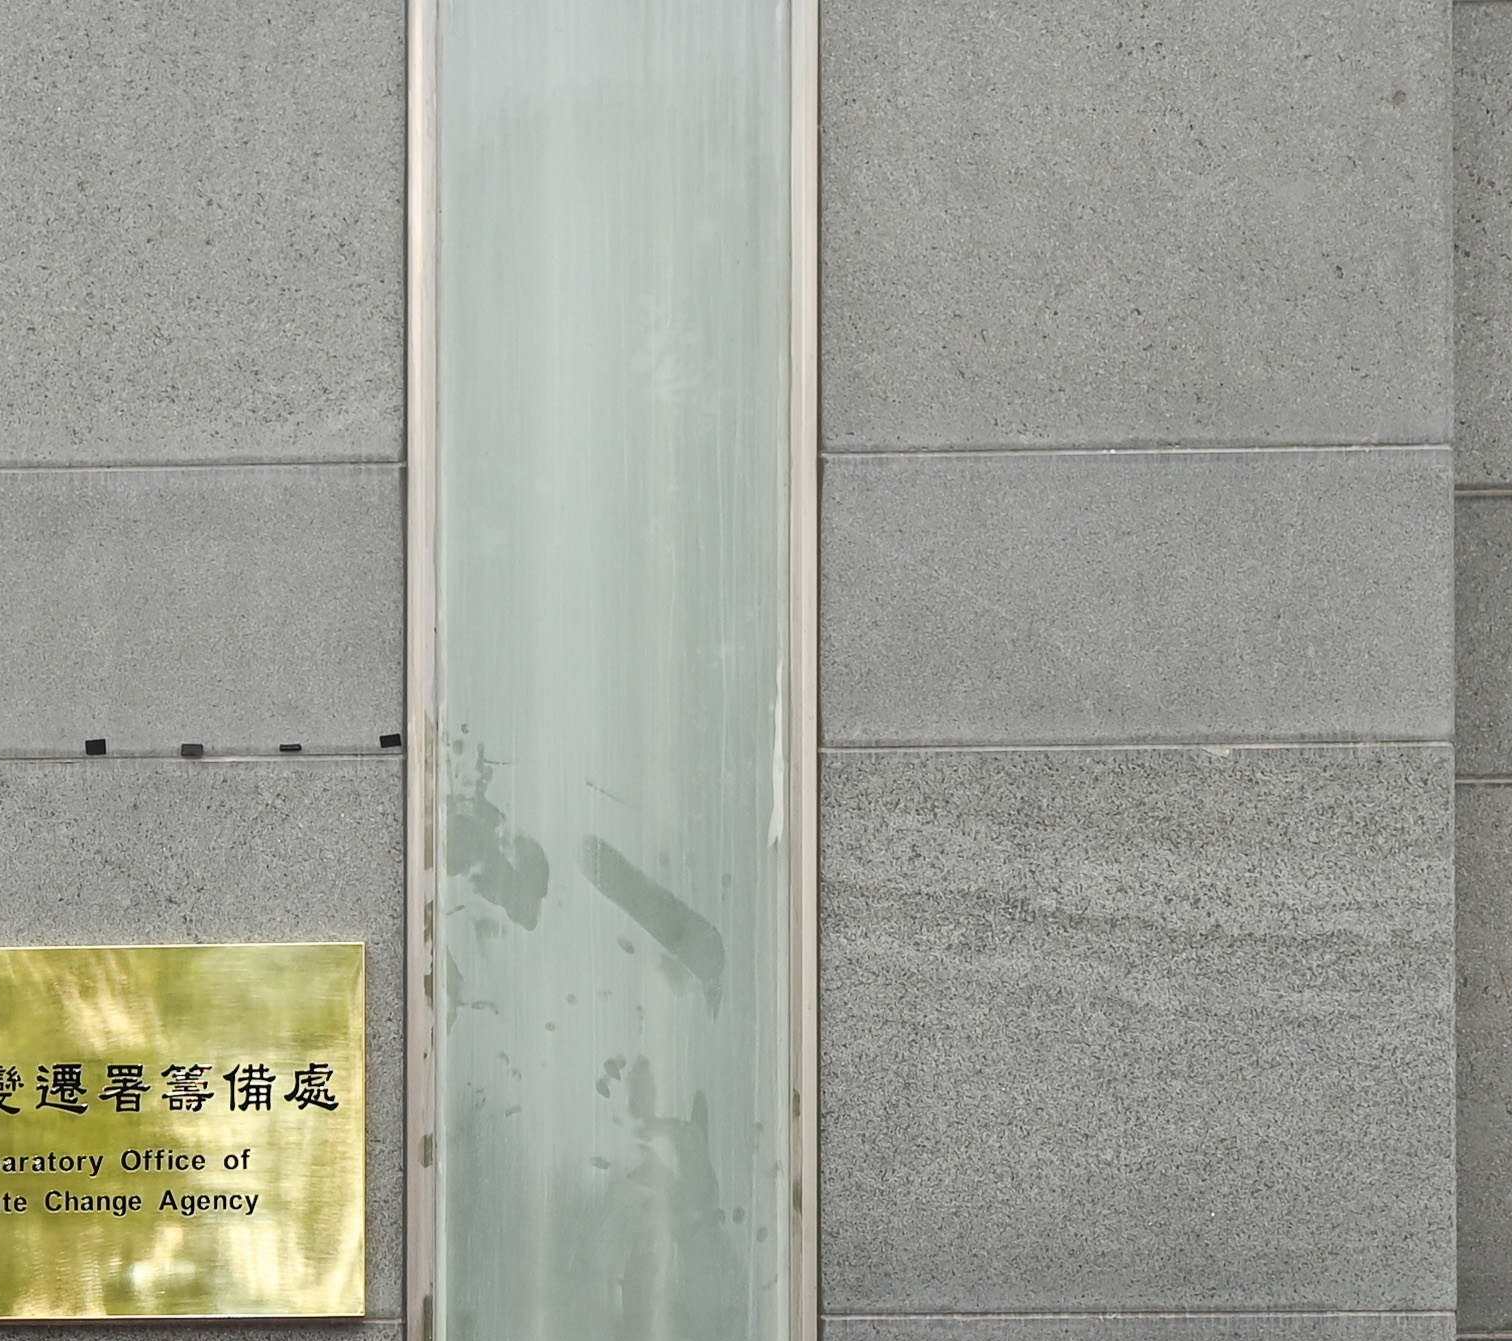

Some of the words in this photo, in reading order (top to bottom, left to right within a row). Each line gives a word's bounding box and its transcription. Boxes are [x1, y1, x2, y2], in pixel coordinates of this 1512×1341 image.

[121, 1149, 206, 1171] Office
[223, 1148, 251, 1170] of
[45, 1190, 142, 1217] Change
[159, 1189, 259, 1216] Agency
